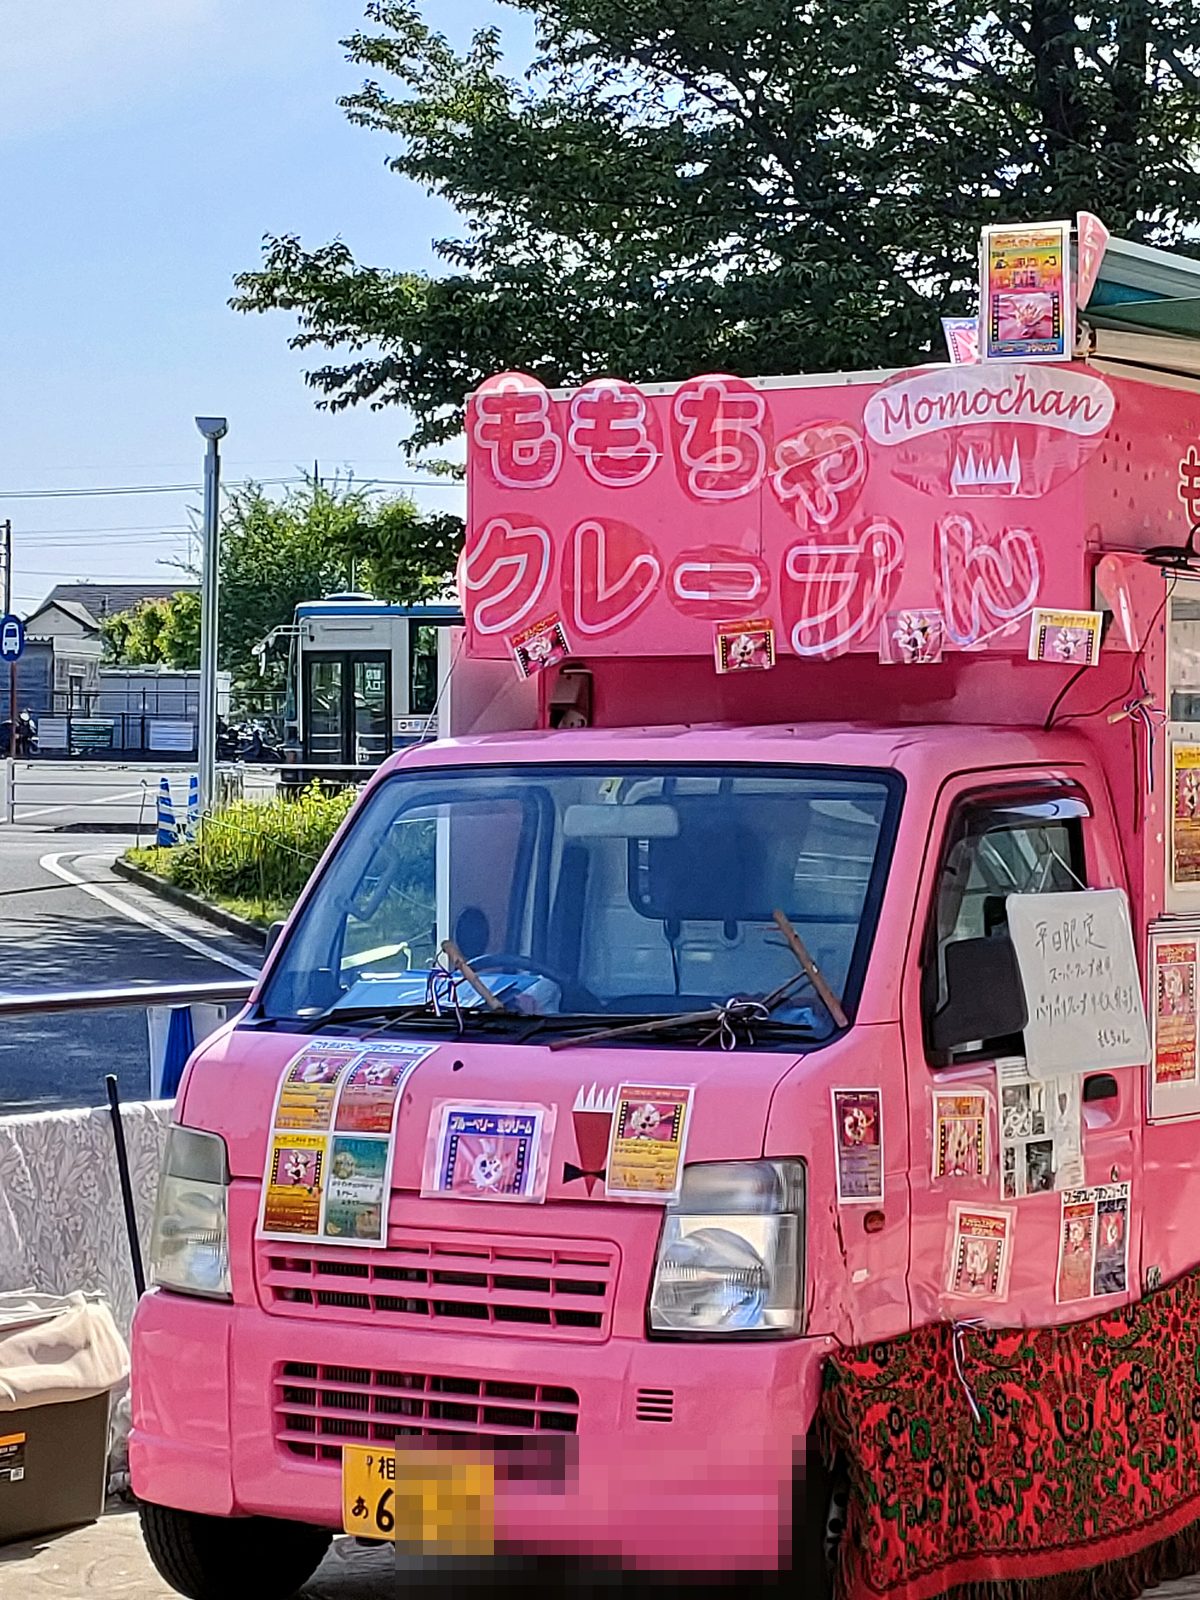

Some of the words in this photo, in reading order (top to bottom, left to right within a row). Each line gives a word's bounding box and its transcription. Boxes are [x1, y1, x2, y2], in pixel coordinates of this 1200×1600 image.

[881, 374, 1103, 435] Momochan
[1035, 913, 1107, 959] 平日限定
